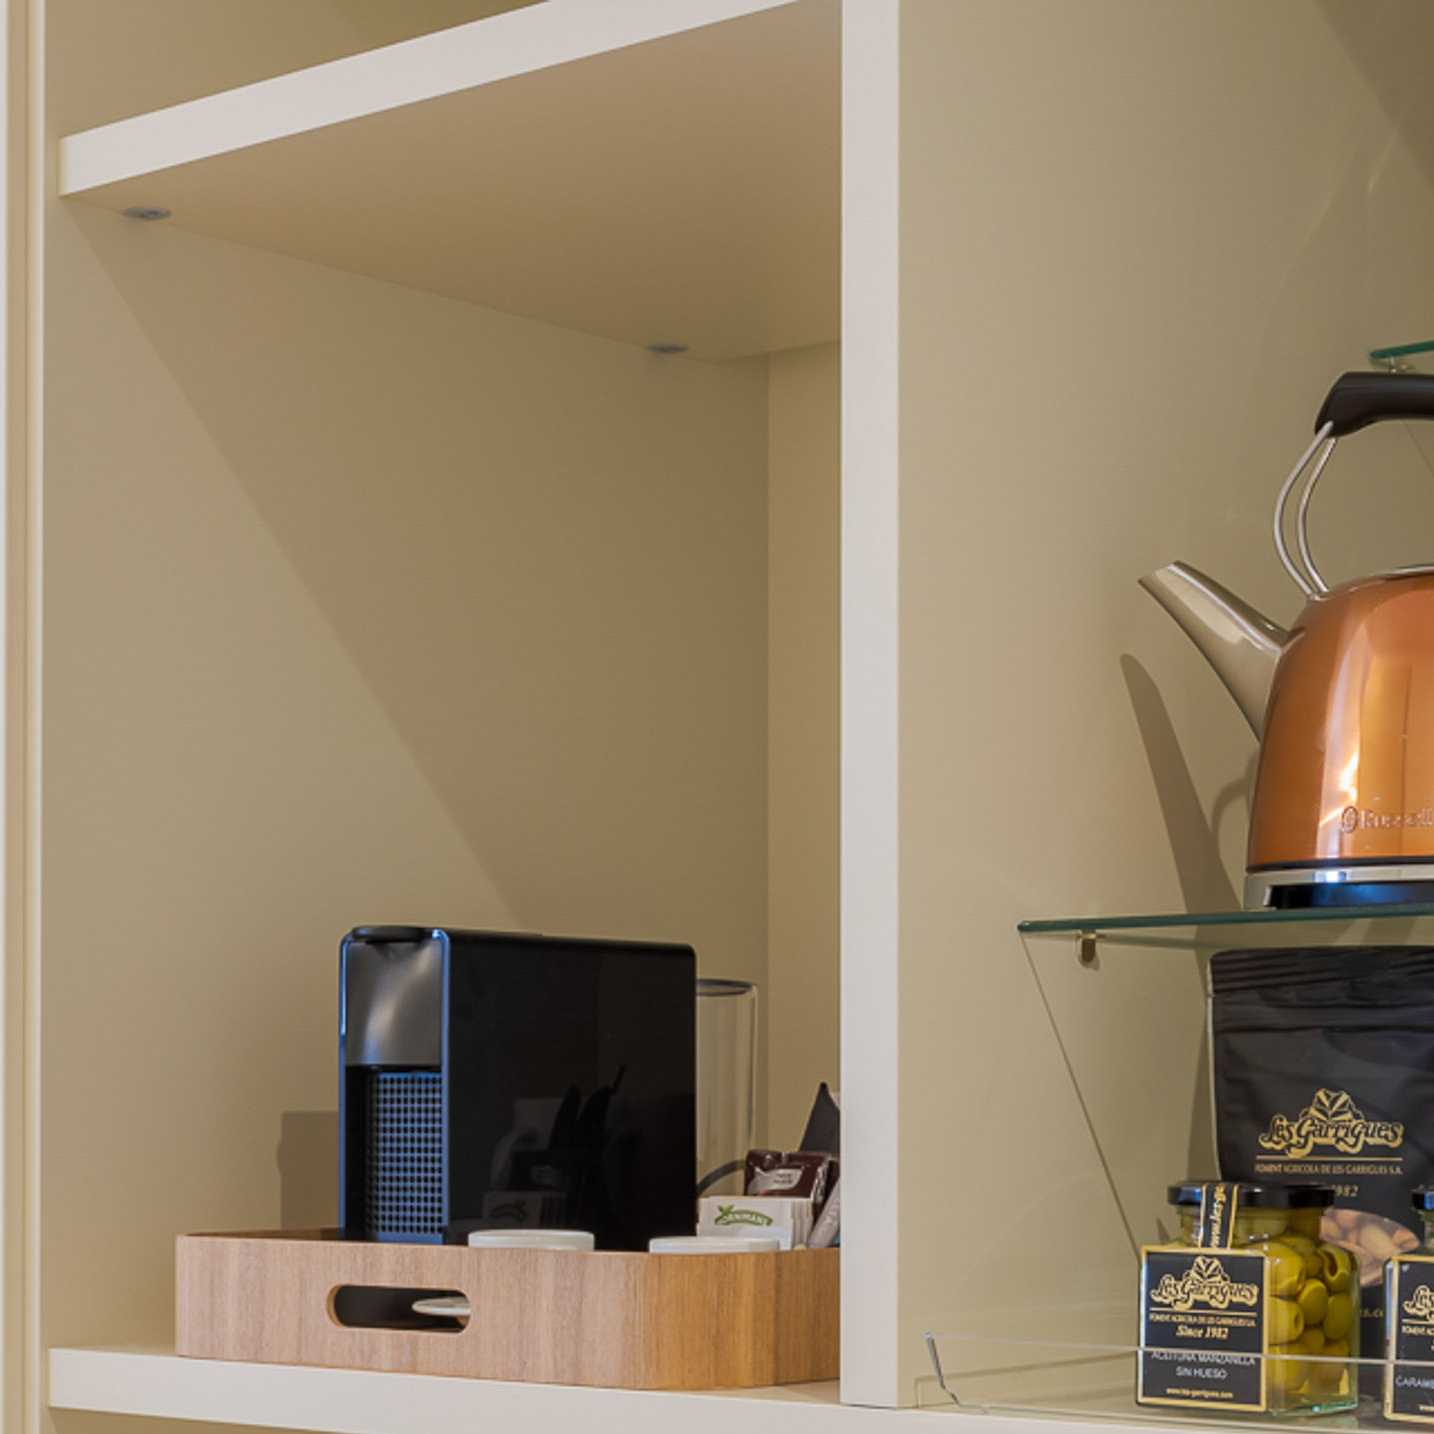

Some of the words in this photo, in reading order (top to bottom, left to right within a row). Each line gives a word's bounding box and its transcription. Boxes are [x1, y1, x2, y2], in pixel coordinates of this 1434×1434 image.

[1175, 1324, 1204, 1338] Since
[1175, 1366, 1193, 1377] SIN
[1193, 1367, 1228, 1379] HUESO
